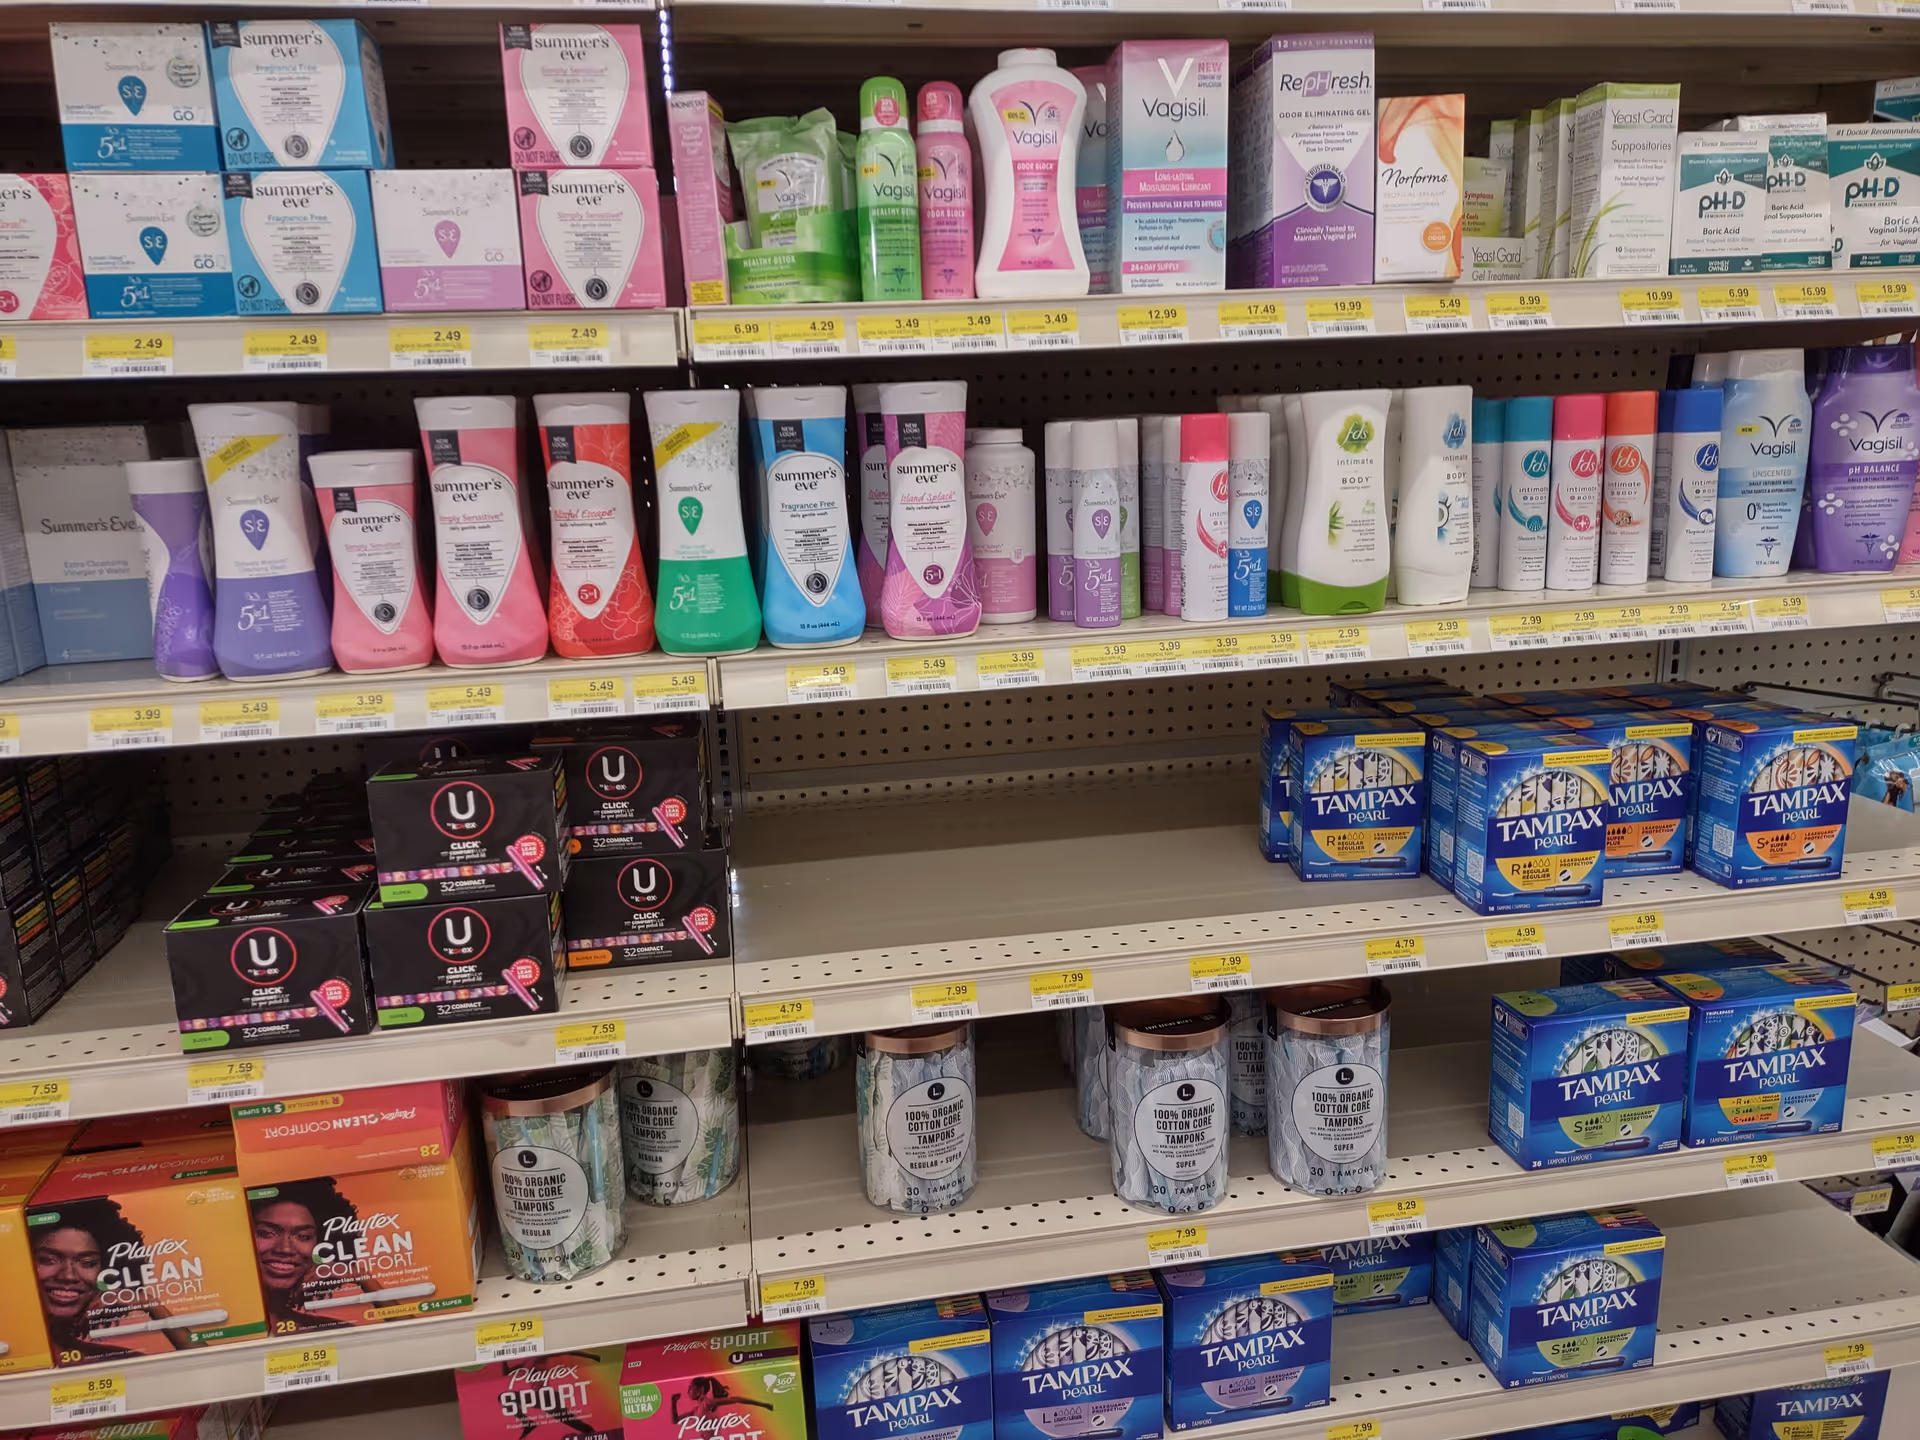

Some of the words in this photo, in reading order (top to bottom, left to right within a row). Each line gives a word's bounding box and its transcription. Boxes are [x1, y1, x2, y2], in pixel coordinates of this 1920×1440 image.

[244, 31, 322, 45] summer's
[535, 36, 609, 48] summer's
[271, 46, 298, 58] eve
[561, 50, 586, 60] eve
[1198, 62, 1221, 73] NEW
[173, 110, 194, 121] GO
[1142, 98, 1208, 122] Vagisil
[1279, 111, 1302, 119] ODOR
[1304, 110, 1355, 118] ELIMINATING
[1611, 110, 1641, 124] Yeast
[1643, 109, 1673, 124] Gard
[1013, 130, 1057, 147] Vagisil
[1611, 140, 1671, 153] Suppositories
[1382, 167, 1448, 187] Norforms
[256, 181, 333, 196] summer's
[552, 181, 624, 194] summer's
[1845, 178, 1899, 208] pH-D
[283, 197, 309, 208] eve
[576, 195, 602, 205] eve
[1699, 191, 1746, 218] pH-D
[1771, 203, 1788, 211] Boric
[1789, 203, 1804, 211] Acid
[1703, 227, 1722, 235] Boric
[1724, 227, 1739, 235] Acid
[194, 258, 214, 269] GO
[1472, 270, 1485, 281] Gel
[1488, 271, 1520, 280] Treatment
[1729, 289, 1748, 298] 6.99
[1801, 287, 1826, 297] 16.99
[1882, 284, 1906, 294] 18.99
[1519, 296, 1540, 306] 8.99
[1647, 291, 1672, 301] 10.99
[1334, 302, 1361, 312] 19.99
[1440, 299, 1460, 308] 5.49
[1148, 310, 1177, 319] 12.99
[1247, 305, 1276, 314] 17.49
[896, 319, 919, 328] 3.49
[968, 316, 990, 325] 3.49
[1045, 314, 1067, 323] 3.49
[734, 324, 759, 333] 6.99
[810, 322, 834, 330] 4.29
[434, 331, 461, 340] 2.49
[571, 328, 597, 338] 2.49
[135, 339, 162, 349] 2.49
[290, 335, 317, 345] 2.49
[1750, 442, 1796, 458] Vagisil
[1849, 437, 1903, 454] Vagisil
[1753, 469, 1792, 478] UNSCENTED
[1849, 466, 1861, 476] pH
[1864, 464, 1900, 474] BALANCE
[434, 478, 502, 492] summer's
[1342, 476, 1369, 484] BODY
[781, 501, 817, 511] Fragrance
[819, 500, 835, 508] Free
[342, 514, 400, 526] summer's
[1783, 598, 1801, 607] 5.99
[1621, 608, 1641, 618] 2.99
[1669, 605, 1688, 614] 2.99
[1521, 616, 1542, 625] 2.99
[1575, 612, 1594, 622] 2.99
[1438, 622, 1458, 631] 2.99
[1338, 629, 1359, 638] 2.99
[1159, 642, 1180, 650] 3.99
[1217, 638, 1237, 647] 3.99
[1105, 646, 1126, 655] 3.99
[1012, 653, 1034, 662] 3.99
[823, 667, 846, 676] 5.49
[590, 682, 613, 692] 5.49
[672, 677, 695, 686] 5.49
[466, 687, 491, 698] 5.49
[357, 695, 382, 705] 3.99
[242, 702, 267, 713] 5.49
[134, 709, 160, 720] 3.99
[1311, 786, 1416, 815] TAMPAX
[1749, 782, 1845, 816] TAMPAX
[448, 791, 475, 820] U
[1497, 807, 1603, 842] TAMPAX
[451, 841, 481, 850] CLICK
[440, 882, 454, 892] 32
[455, 879, 486, 888] COMPACT
[1869, 891, 1886, 900] 4.99
[1637, 915, 1655, 925] 4.99
[1517, 927, 1536, 937] 4.99
[1395, 939, 1415, 950] 4.79
[249, 937, 277, 966] U
[1221, 957, 1241, 967] 7.99
[448, 965, 477, 974] CLICK
[1062, 973, 1083, 983] 7.99
[252, 987, 282, 995] CLICK
[946, 986, 967, 996] 7.99
[780, 1002, 802, 1013] 4.79
[243, 1028, 257, 1038] 32
[258, 1024, 289, 1033] COMPACT
[592, 1024, 615, 1034] 7.59
[227, 1063, 252, 1074] 7.59
[1724, 1047, 1825, 1083] TAMPAX
[1558, 1062, 1660, 1102] TAMPAX
[32, 1083, 58, 1094] 7.59
[1311, 1092, 1337, 1103] 100%
[1339, 1088, 1373, 1102] ORGANIC
[905, 1110, 929, 1122] 100%
[932, 1099, 963, 1119] ORGANIC
[1153, 1108, 1178, 1120] 100%
[1181, 1103, 1215, 1119] ORGANIC
[1314, 1102, 1348, 1114] COTTON
[1351, 1099, 1370, 1112] CORE
[908, 1118, 941, 1132] COTTON
[943, 1112, 961, 1128] CORE
[1156, 1118, 1190, 1131] COTTON
[1193, 1116, 1212, 1129] CORE
[1323, 1115, 1363, 1127] TAMPONS
[918, 1129, 955, 1145] TAMPONS
[1165, 1131, 1205, 1144] TAMPONS
[1695, 1138, 1705, 1146] 34
[1334, 1143, 1353, 1151] SUPER
[1176, 1160, 1196, 1168] SUPER
[505, 1185, 536, 1197] COTTON
[539, 1184, 562, 1196] CORE
[513, 1201, 554, 1212] TAMPONS
[1397, 1201, 1416, 1211] 8.29
[323, 1213, 400, 1241] Playtex
[522, 1228, 551, 1237] REGULAR
[1176, 1228, 1196, 1239] 7.99
[107, 1238, 188, 1267] Playtex
[312, 1231, 413, 1264] CLEAN
[316, 1252, 414, 1278] COMFORT
[98, 1257, 203, 1290] CLEAN
[794, 1280, 815, 1290] 7.99
[101, 1279, 203, 1306] COMFORT
[1537, 1289, 1637, 1327] TAMPAX
[276, 1321, 296, 1333] 28
[510, 1321, 533, 1332] 7.99
[1201, 1328, 1305, 1368] TAMPAX
[60, 1350, 81, 1363] 30
[303, 1350, 326, 1361] 8.59
[508, 1364, 578, 1390] Playtex
[1022, 1358, 1133, 1395] TAMPAX
[88, 1379, 112, 1391] 8.59
[501, 1381, 591, 1417] SPORT
[624, 1402, 653, 1414] ULTRA
[846, 1386, 961, 1428] TAMPAX
